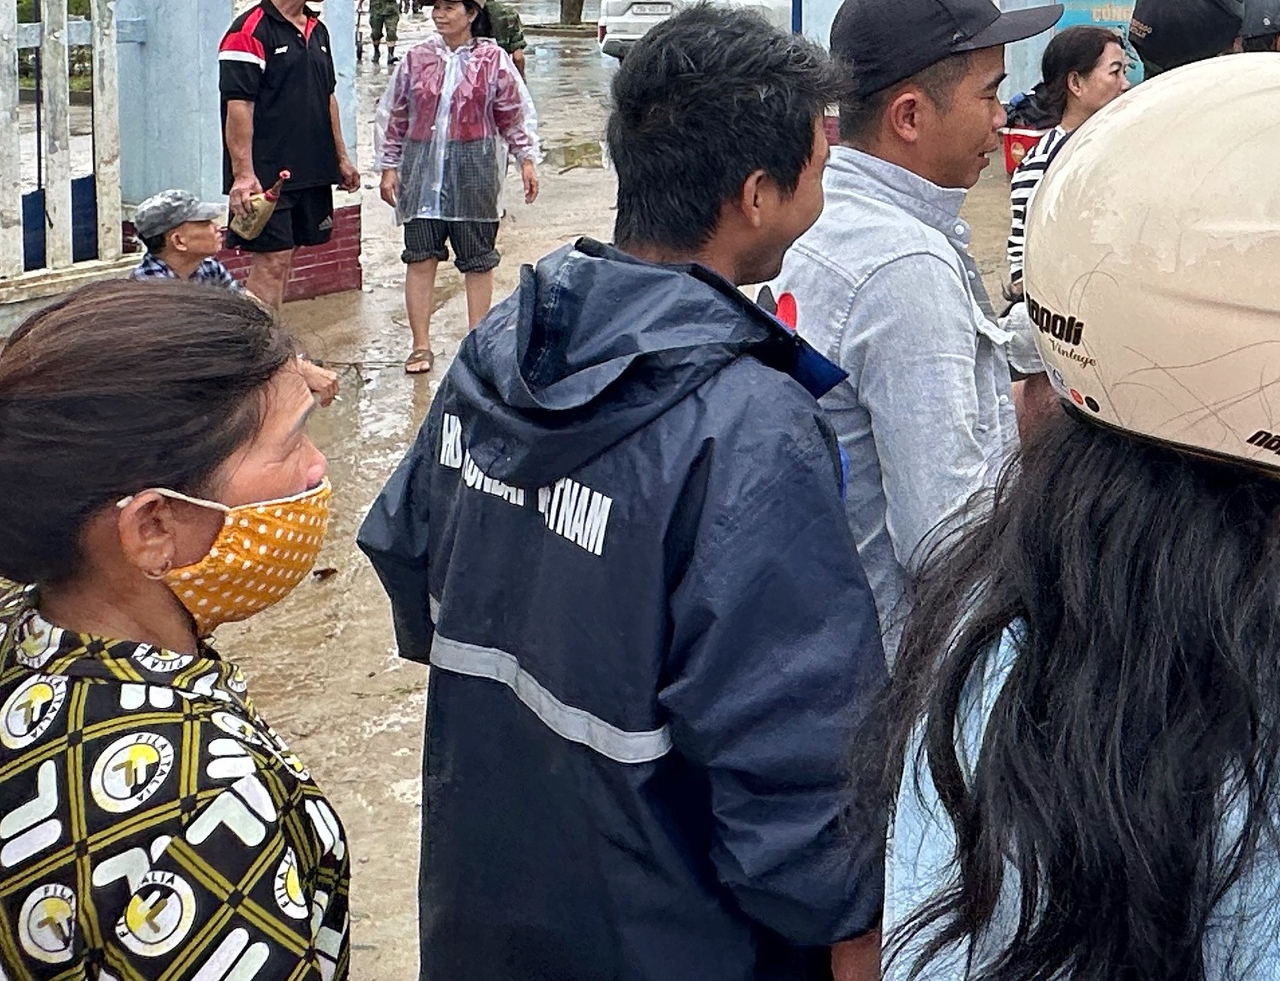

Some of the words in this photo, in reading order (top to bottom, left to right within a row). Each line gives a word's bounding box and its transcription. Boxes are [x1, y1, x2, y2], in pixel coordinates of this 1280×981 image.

[1048, 337, 1097, 369] Vintage
[135, 733, 169, 752] FILA
[136, 752, 173, 803] ITALIA
